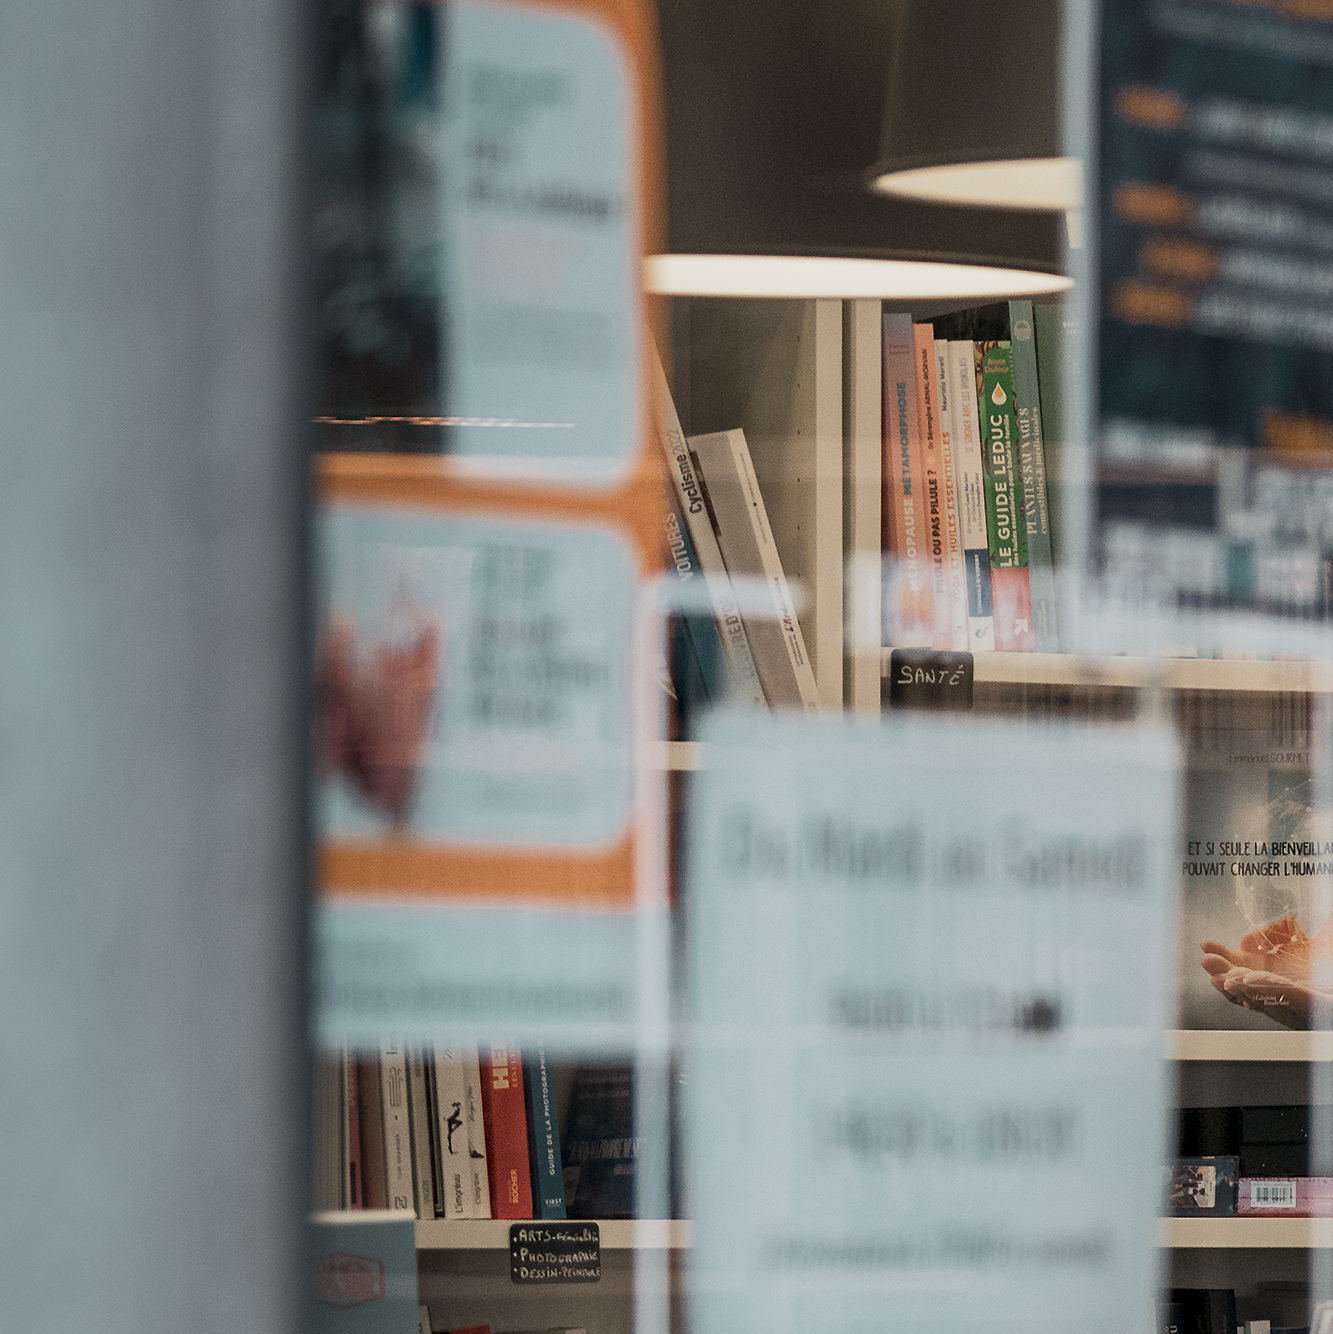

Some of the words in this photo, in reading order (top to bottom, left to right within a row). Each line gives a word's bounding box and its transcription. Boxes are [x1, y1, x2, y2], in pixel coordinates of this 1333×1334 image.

[990, 414, 1007, 475] LEDUC
[928, 479, 939, 516] PILULE
[994, 481, 1010, 541] GUIDE
[929, 517, 941, 537] PAS
[931, 539, 942, 556] OU
[998, 547, 1012, 568] LE
[897, 664, 965, 685] SANTÉ
[1188, 842, 1201, 856] ET
[1206, 842, 1216, 856] SI
[1219, 842, 1249, 856] SEULE
[1254, 842, 1268, 856] LA
[1183, 861, 1226, 876] POUVAIT
[1230, 861, 1280, 876] CHANGER
